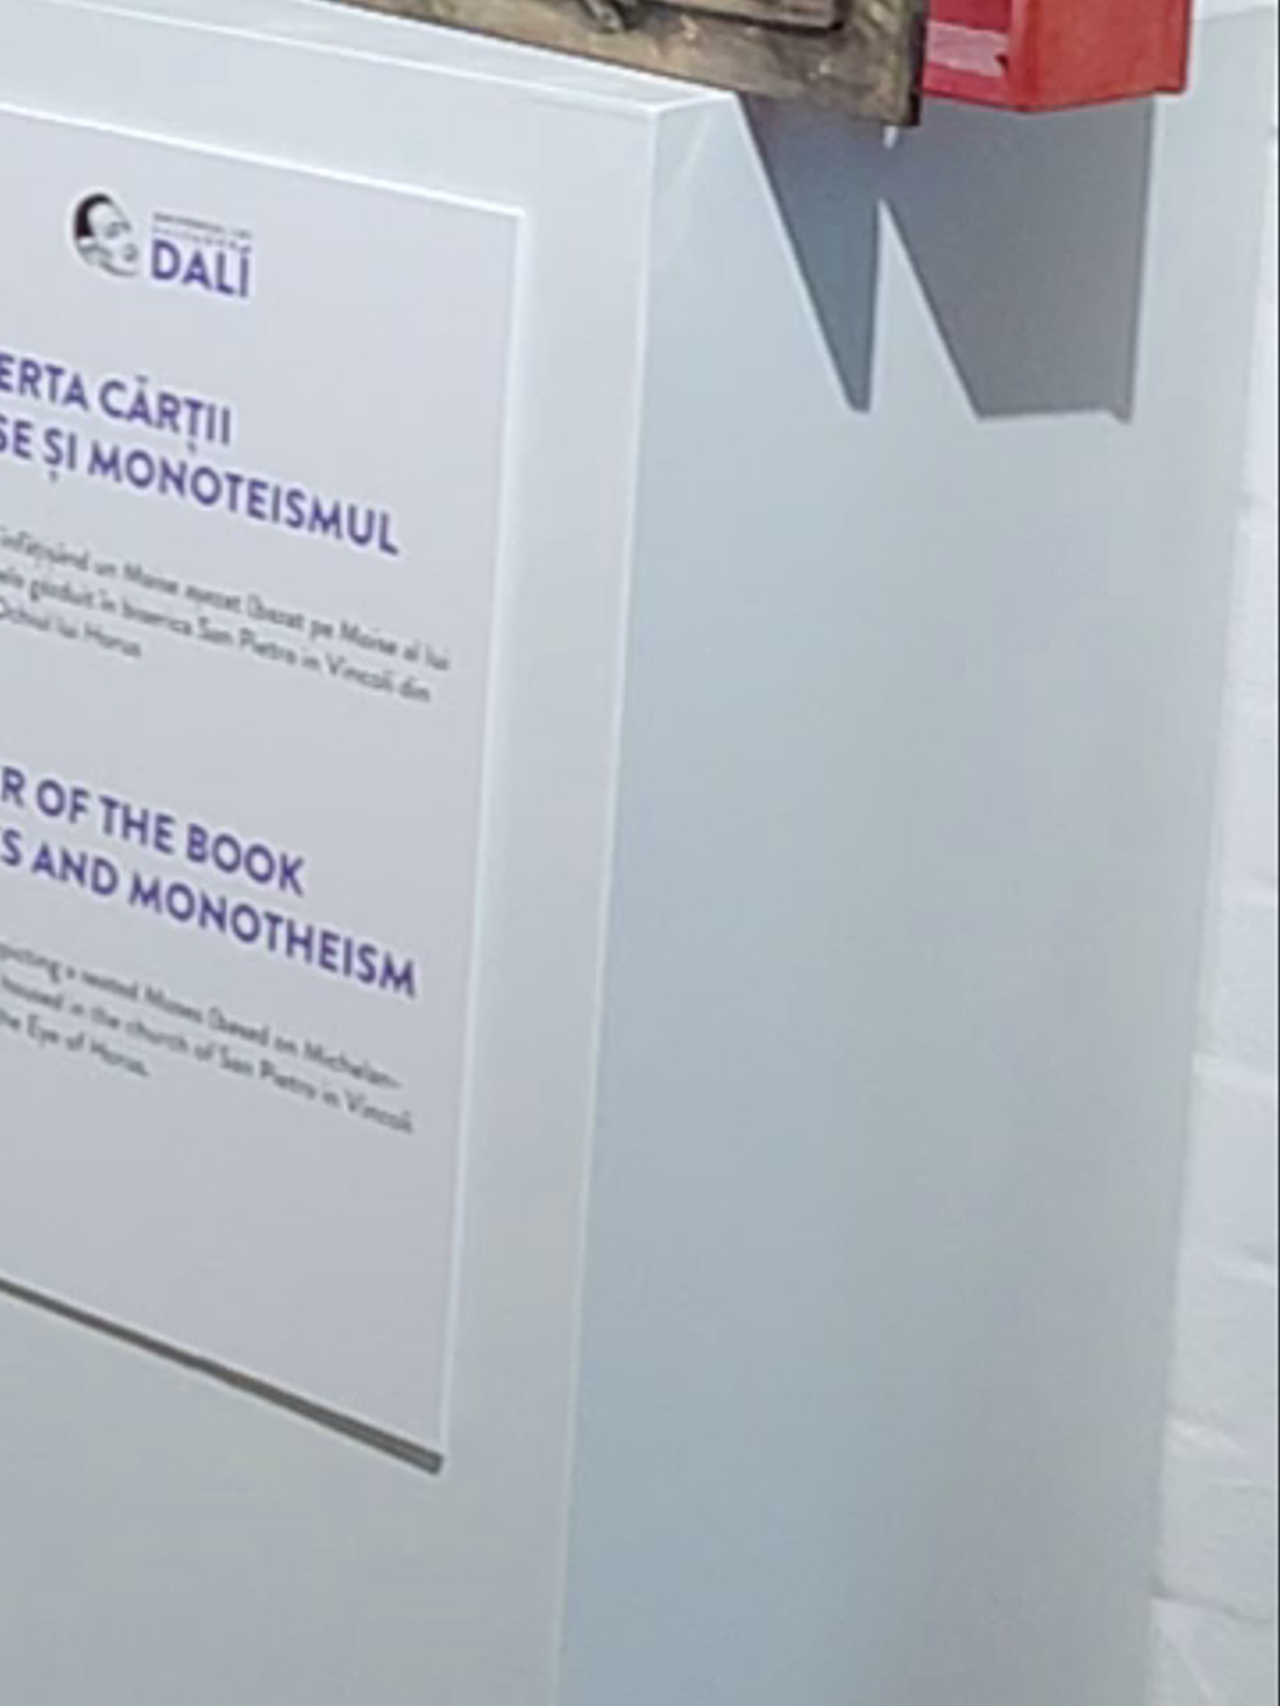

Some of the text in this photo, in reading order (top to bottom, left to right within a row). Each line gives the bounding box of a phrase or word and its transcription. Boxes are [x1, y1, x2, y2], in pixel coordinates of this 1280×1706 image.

[149, 238, 252, 297] DALÍ
[43, 426, 78, 482] ȘI
[88, 436, 399, 555] MONOTEISMUL
[35, 778, 91, 824] OF
[100, 796, 174, 855] THE
[186, 823, 306, 896] BOOK
[32, 841, 119, 897] AND
[128, 871, 417, 998] MONOTHEISM
